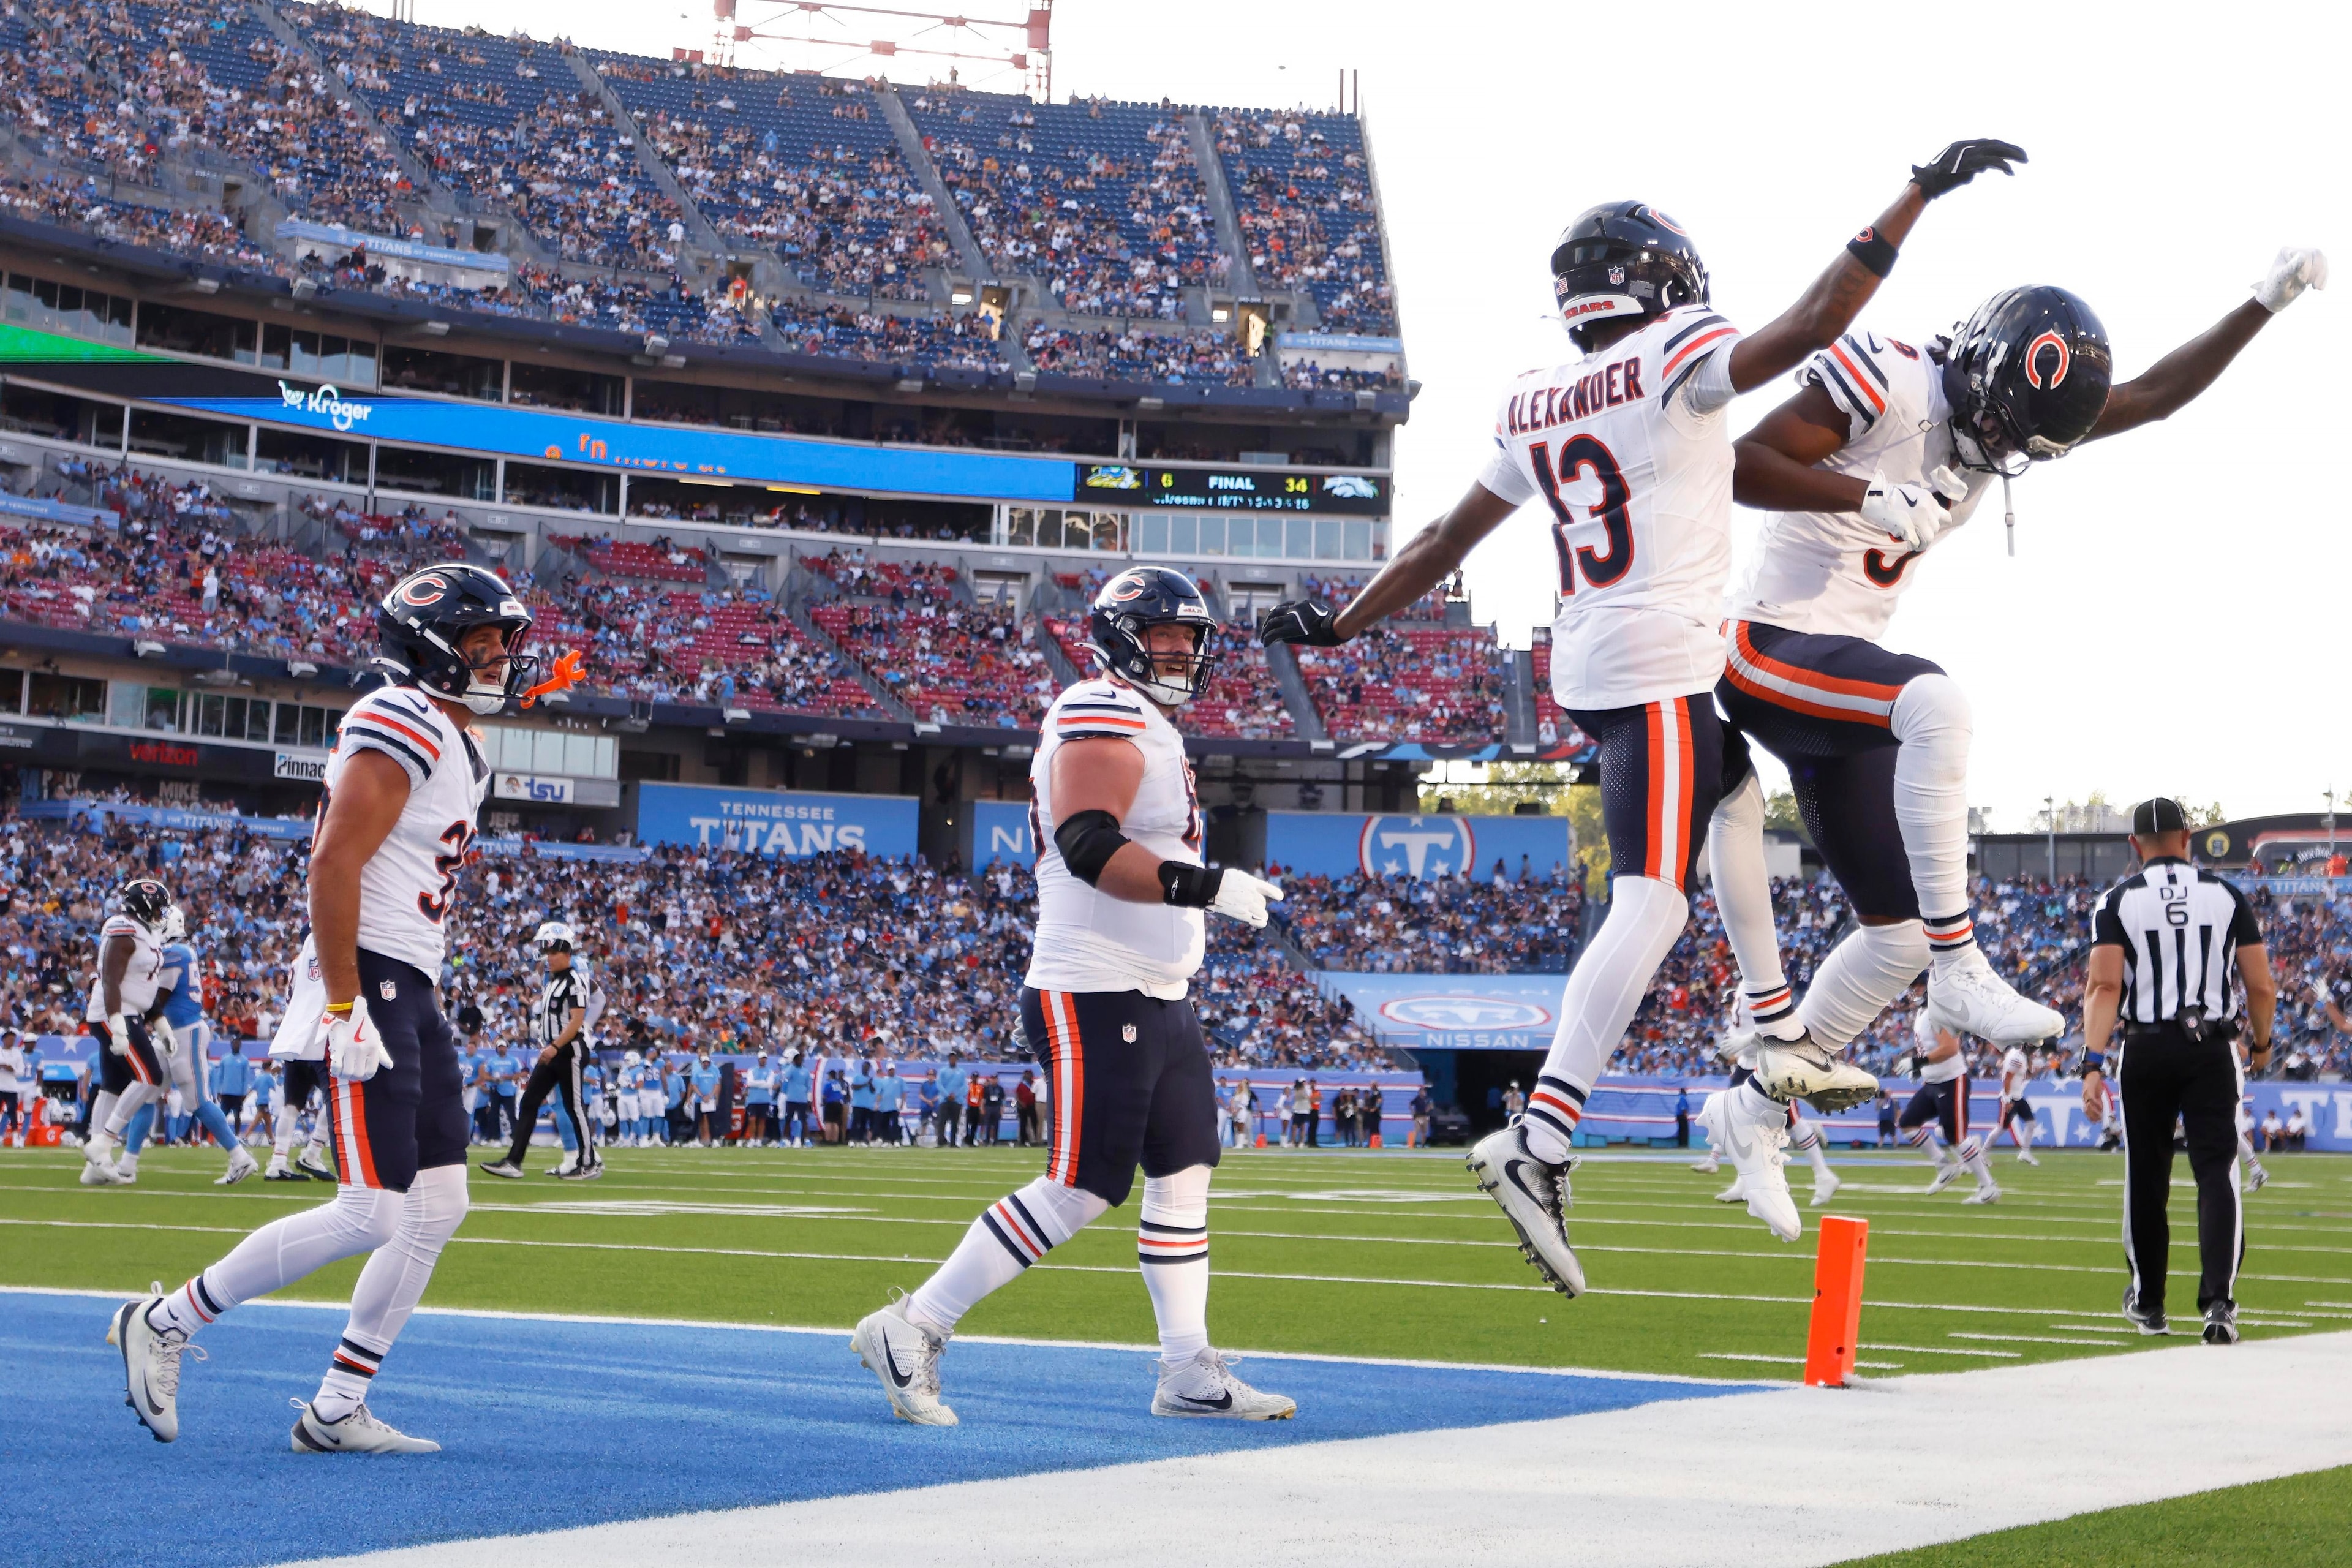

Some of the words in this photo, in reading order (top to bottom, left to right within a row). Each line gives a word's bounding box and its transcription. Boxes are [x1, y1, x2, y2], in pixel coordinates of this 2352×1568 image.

[367, 238, 412, 256] TITANS
[1564, 300, 1615, 320] BEARS
[1507, 356, 1645, 437] ALEXANDER
[307, 383, 372, 431] Kroger
[1208, 475, 1255, 491] FINAL
[1284, 477, 1308, 493] 34
[1528, 433, 1635, 597] 13
[129, 740, 198, 766] verizon
[159, 781, 200, 801] MIKE
[524, 777, 565, 802] tsu
[720, 802, 834, 820] TENNESSEE
[184, 815, 233, 828] TITANS
[2160, 886, 2188, 900] DJ
[2165, 902, 2189, 927] 6
[1426, 1033, 1529, 1049] NISSAN
